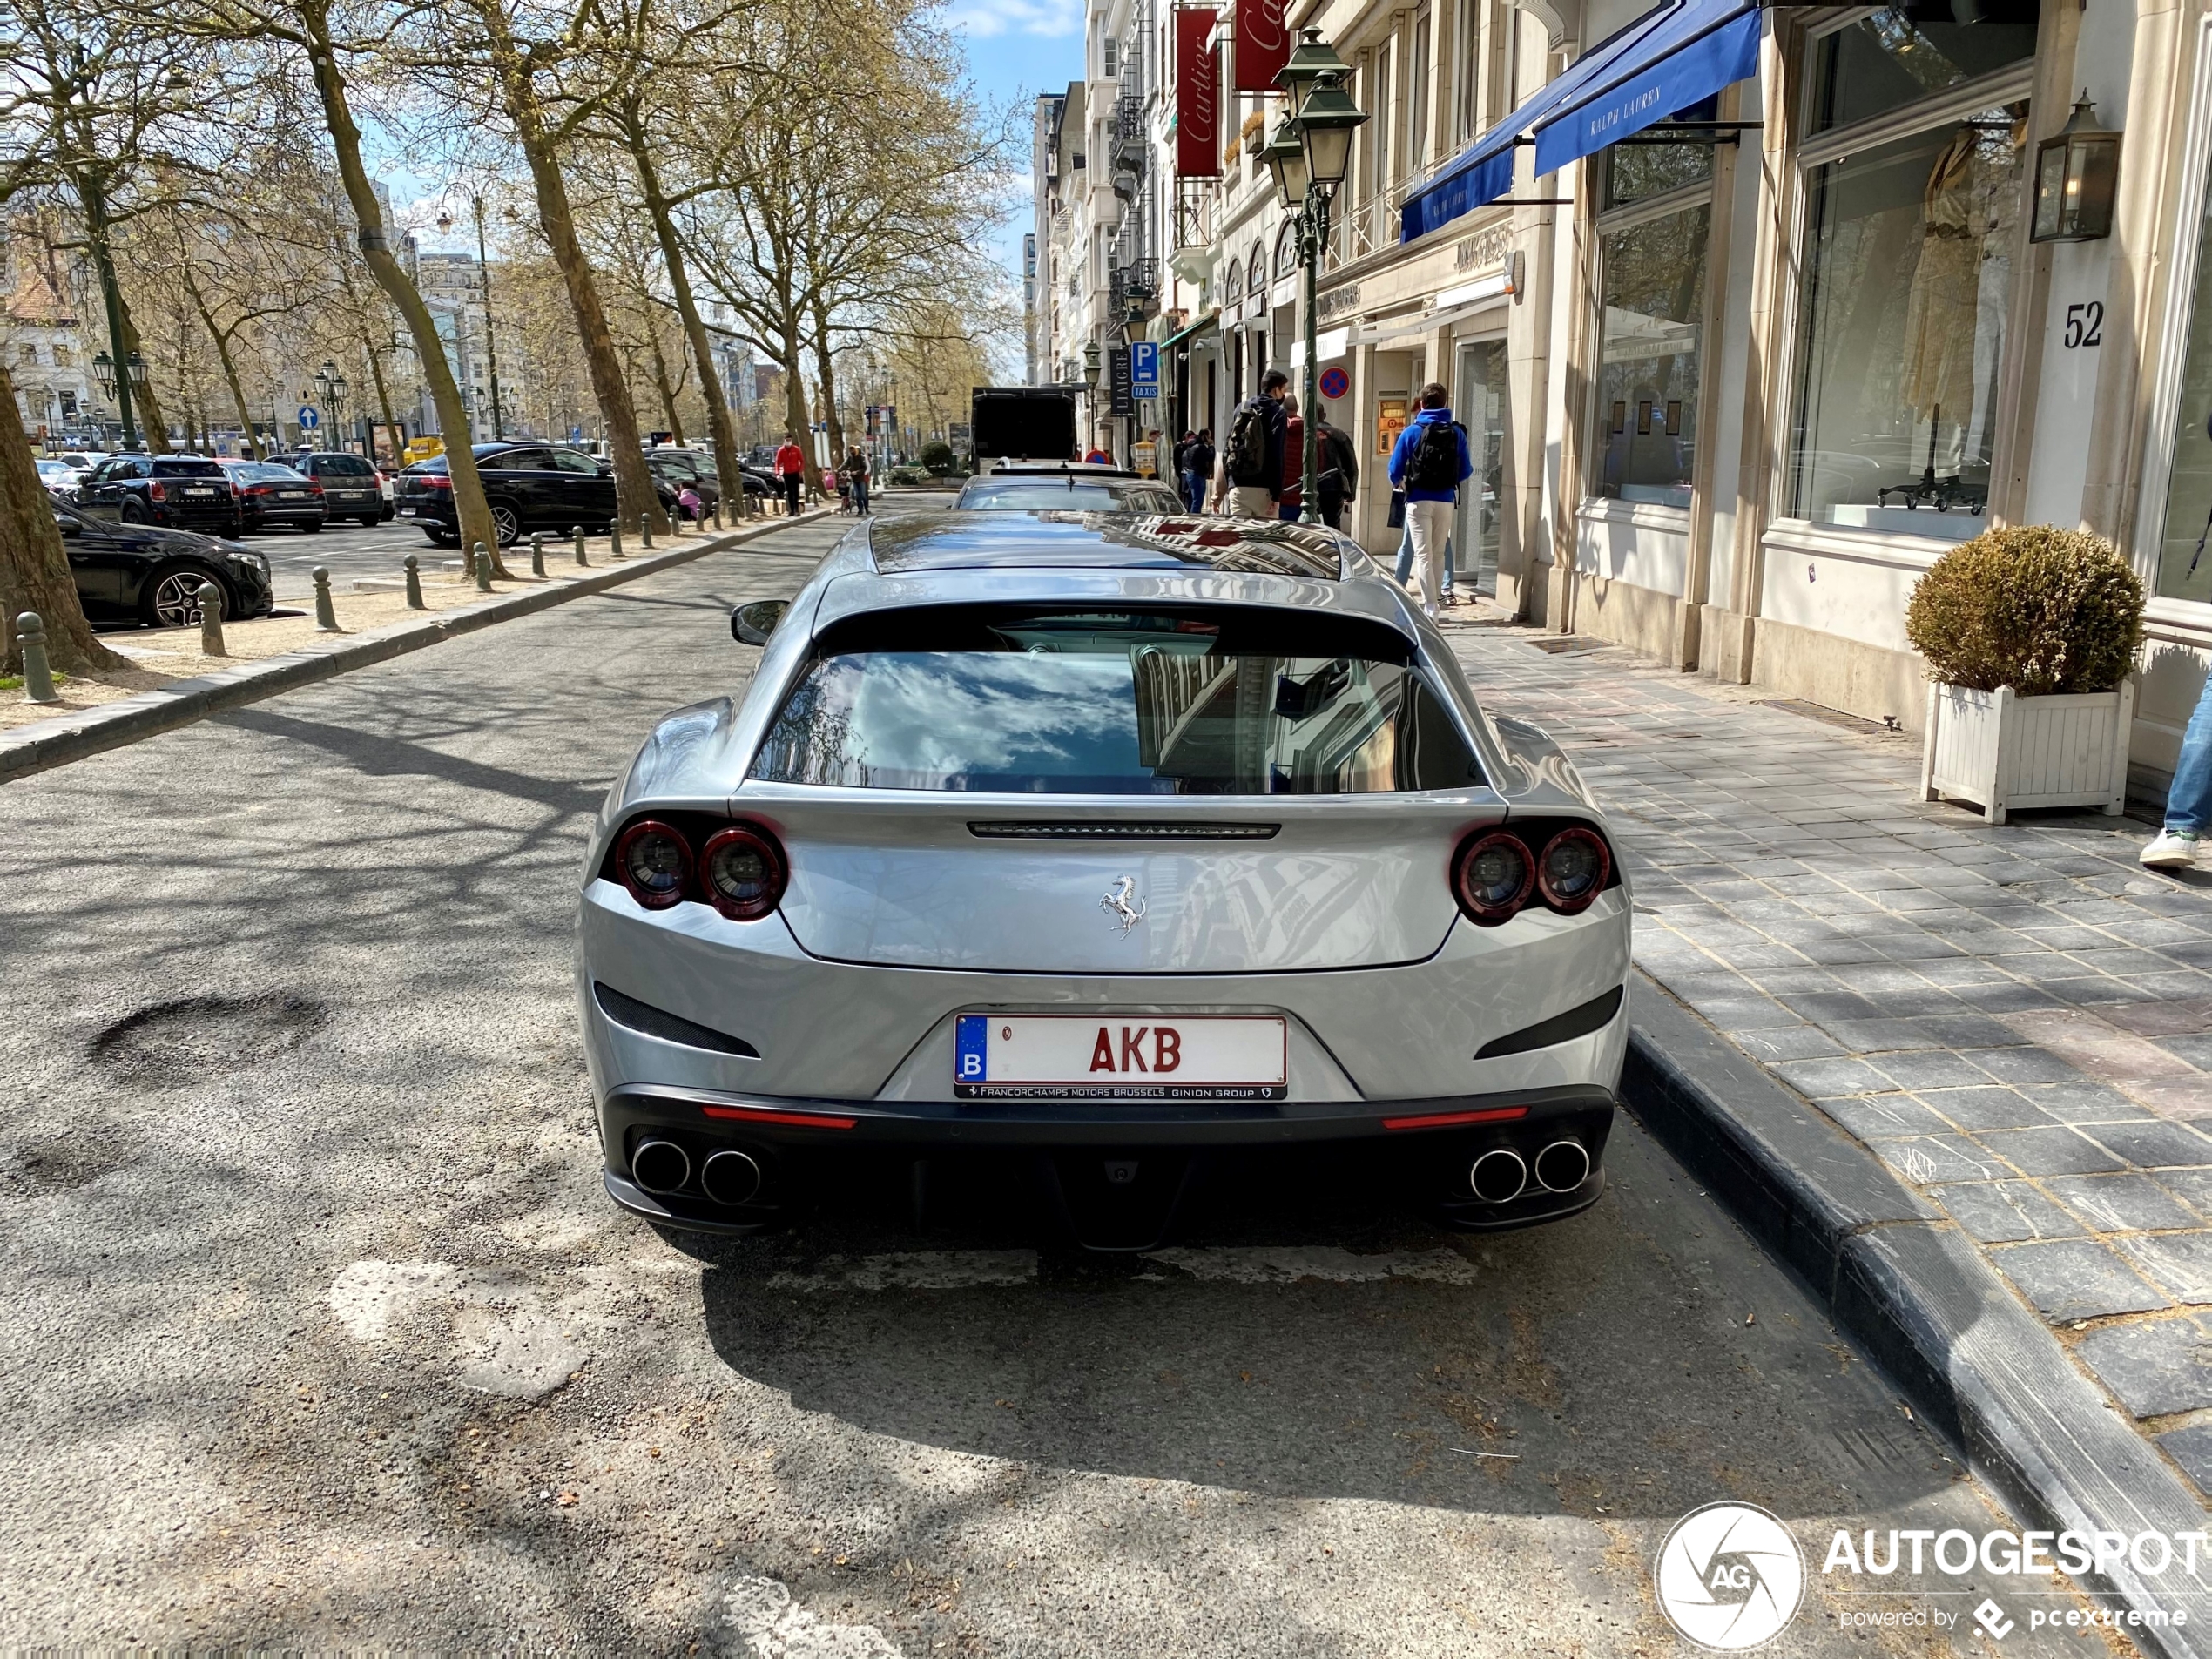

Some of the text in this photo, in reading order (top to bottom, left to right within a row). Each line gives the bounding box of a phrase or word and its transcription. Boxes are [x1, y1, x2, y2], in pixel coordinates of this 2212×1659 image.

[1183, 36, 1211, 142] Cartier
[1590, 85, 1661, 136] RALPH LAUREN
[2065, 301, 2104, 348] 52
[1137, 345, 1152, 367] P
[1116, 354, 1129, 408] LIAIGRE
[1135, 387, 1157, 396] TAXIS
[964, 1054, 981, 1076] B
[1089, 1027, 1181, 1072] AKB
[981, 1087, 1069, 1096] FRANCORCHAMPS
[1171, 1089, 1211, 1097] GINION
